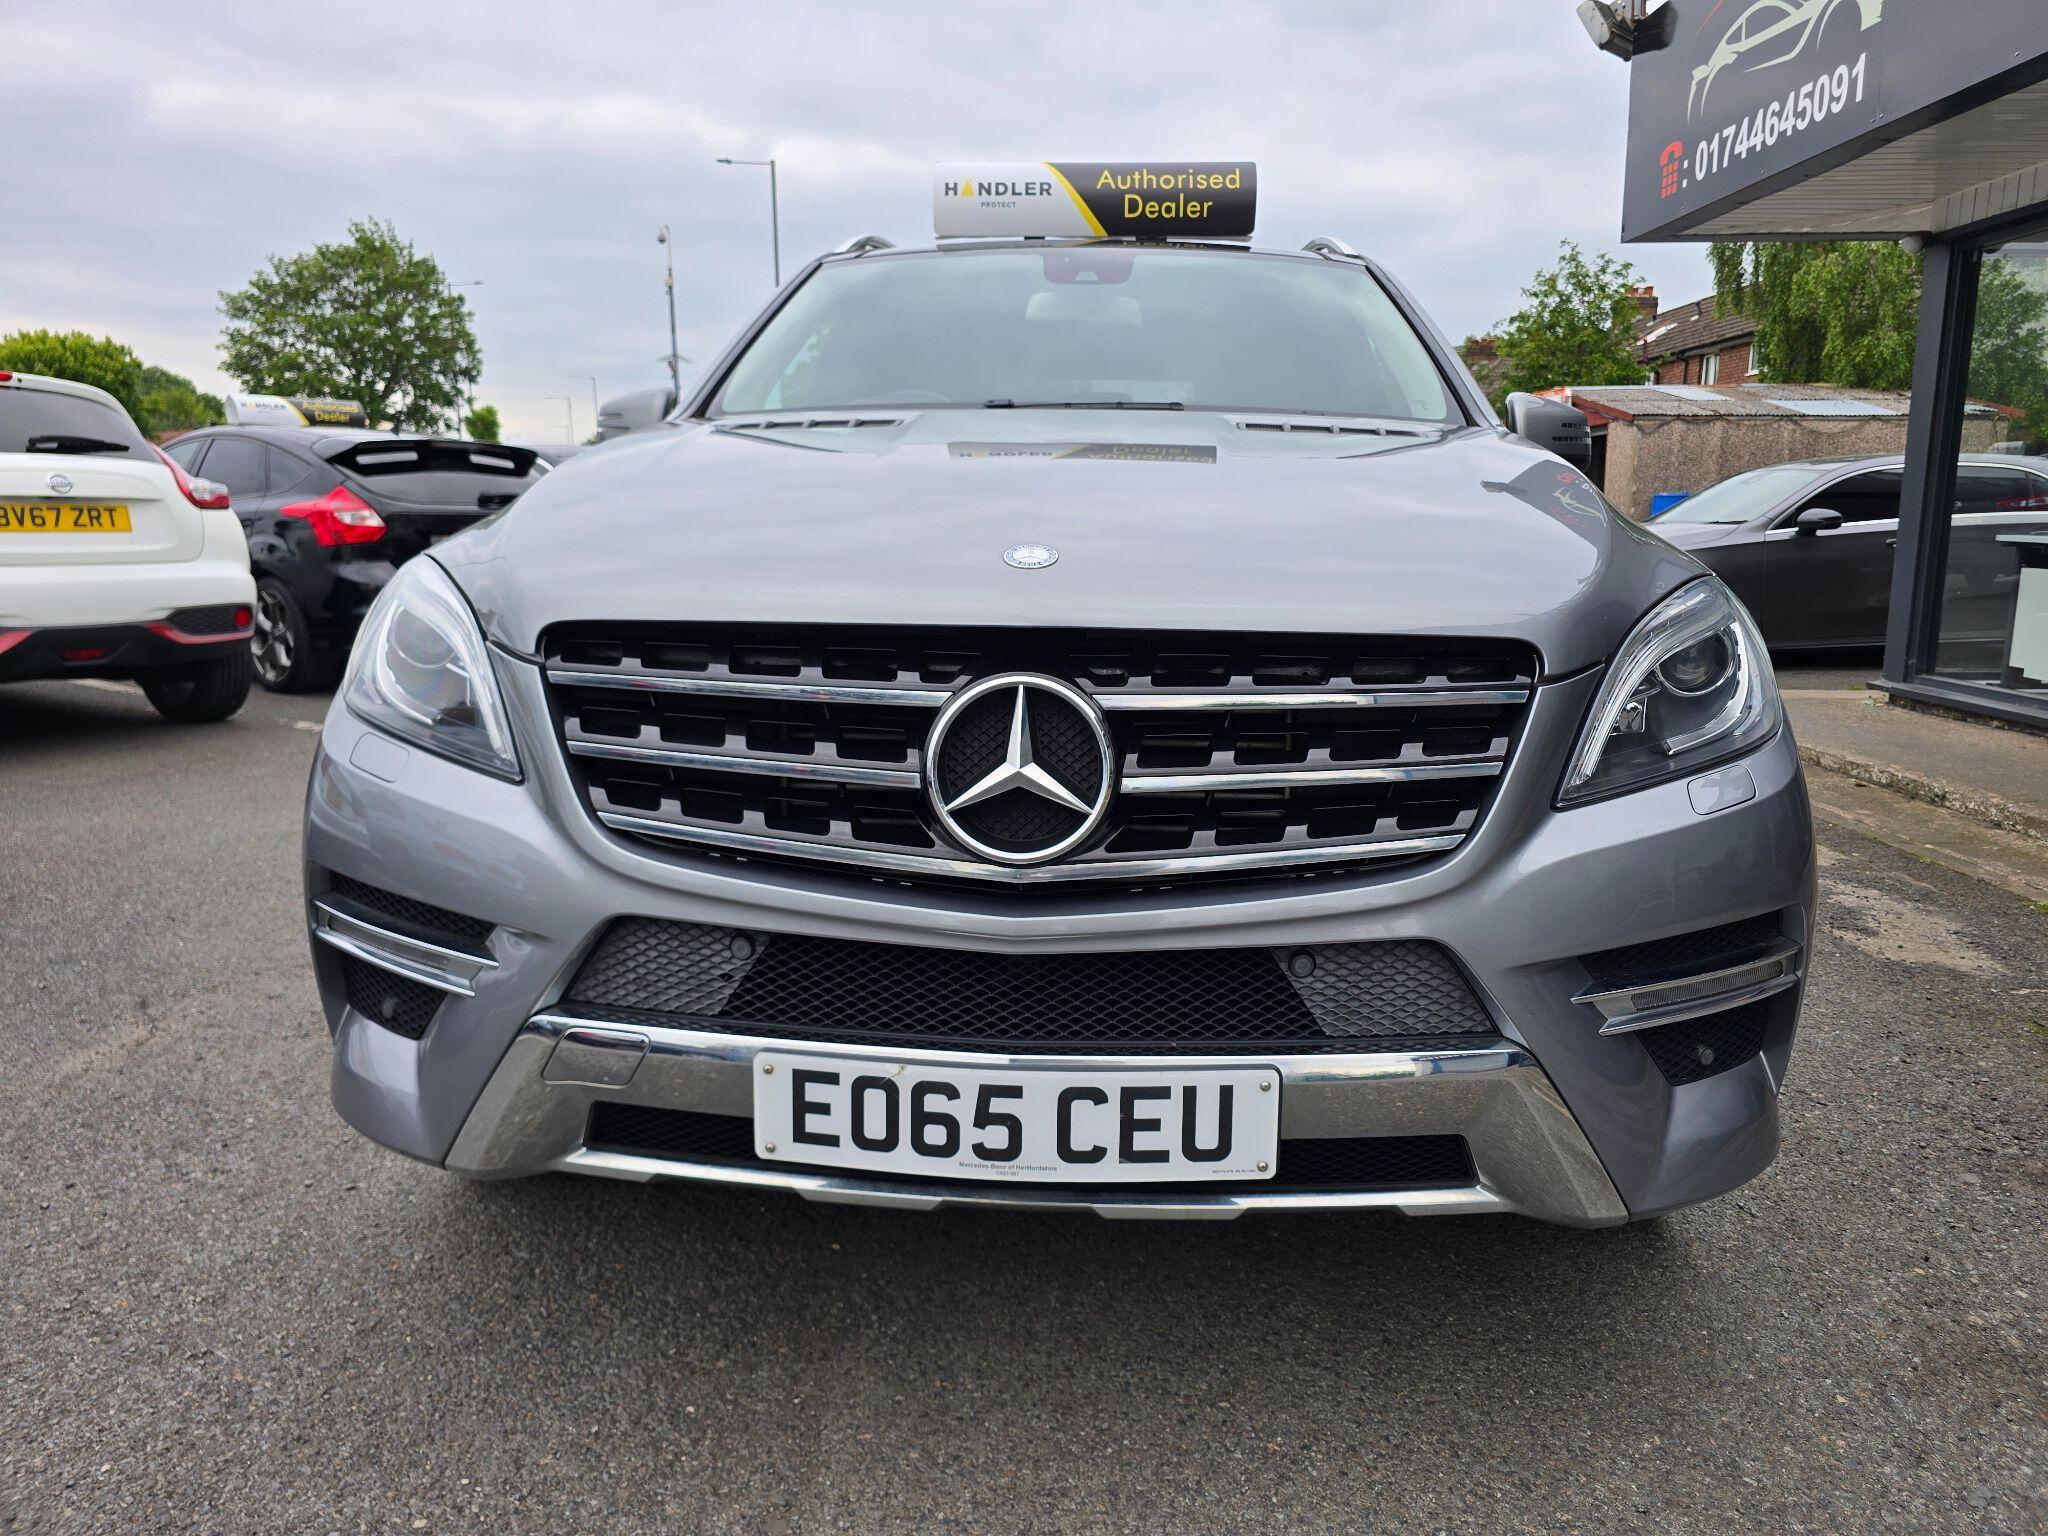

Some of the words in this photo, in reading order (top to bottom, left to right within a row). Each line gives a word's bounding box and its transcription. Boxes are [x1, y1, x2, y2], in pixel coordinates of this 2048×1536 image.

[1694, 51, 1867, 182] 01744645091
[1096, 167, 1241, 190] Authorised
[981, 201, 1017, 209] PROTECT
[1124, 192, 1213, 219] Dealer
[0, 506, 61, 528] BV67
[69, 507, 118, 528] ZRT
[1056, 1084, 1233, 1164] CEU
